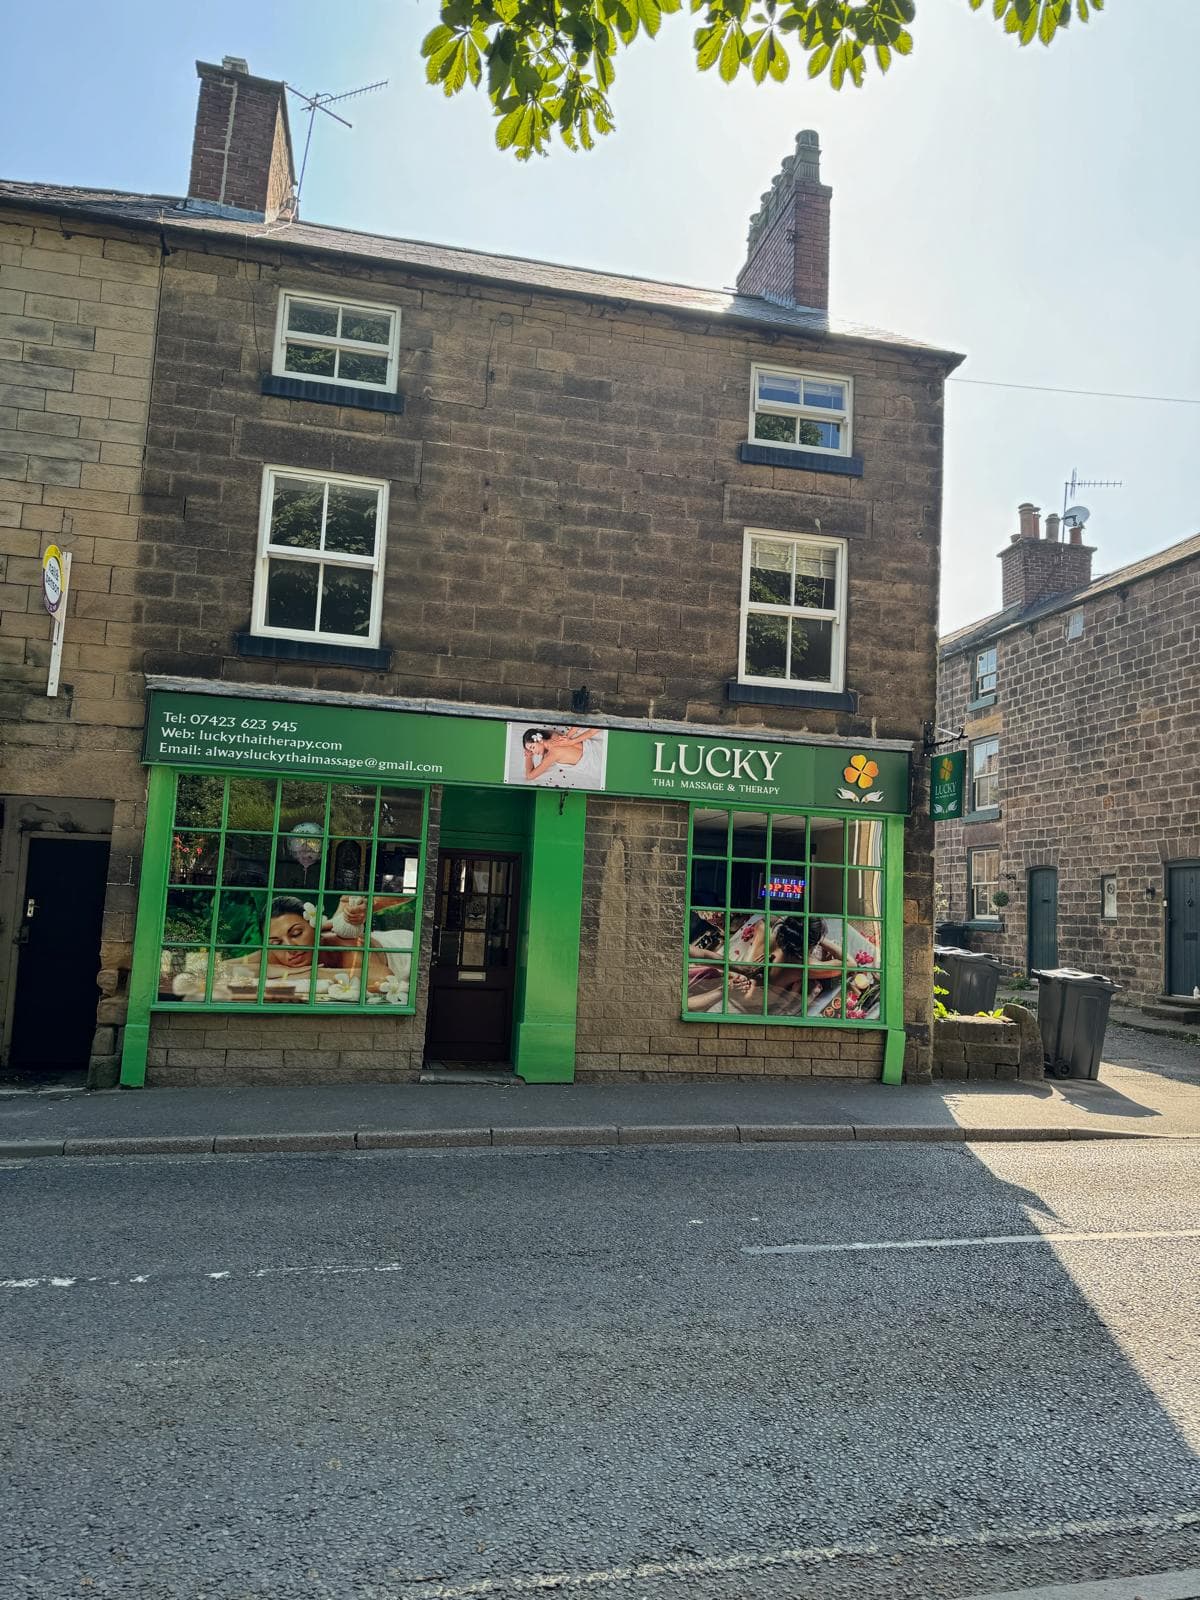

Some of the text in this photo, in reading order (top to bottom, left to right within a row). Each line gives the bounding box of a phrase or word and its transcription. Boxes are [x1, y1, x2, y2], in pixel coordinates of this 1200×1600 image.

[163, 712, 298, 732] Tel: 07423 623 945
[161, 727, 342, 751] Web: luckythaitherapy.com
[159, 742, 443, 773] Email: alwaysluckythaimassage@gmail.com
[652, 741, 783, 782] LUCKY
[652, 778, 780, 795] THAI MASSAGE & THERAPY
[935, 781, 957, 796] LUCKY
[763, 883, 804, 895] OPEN
